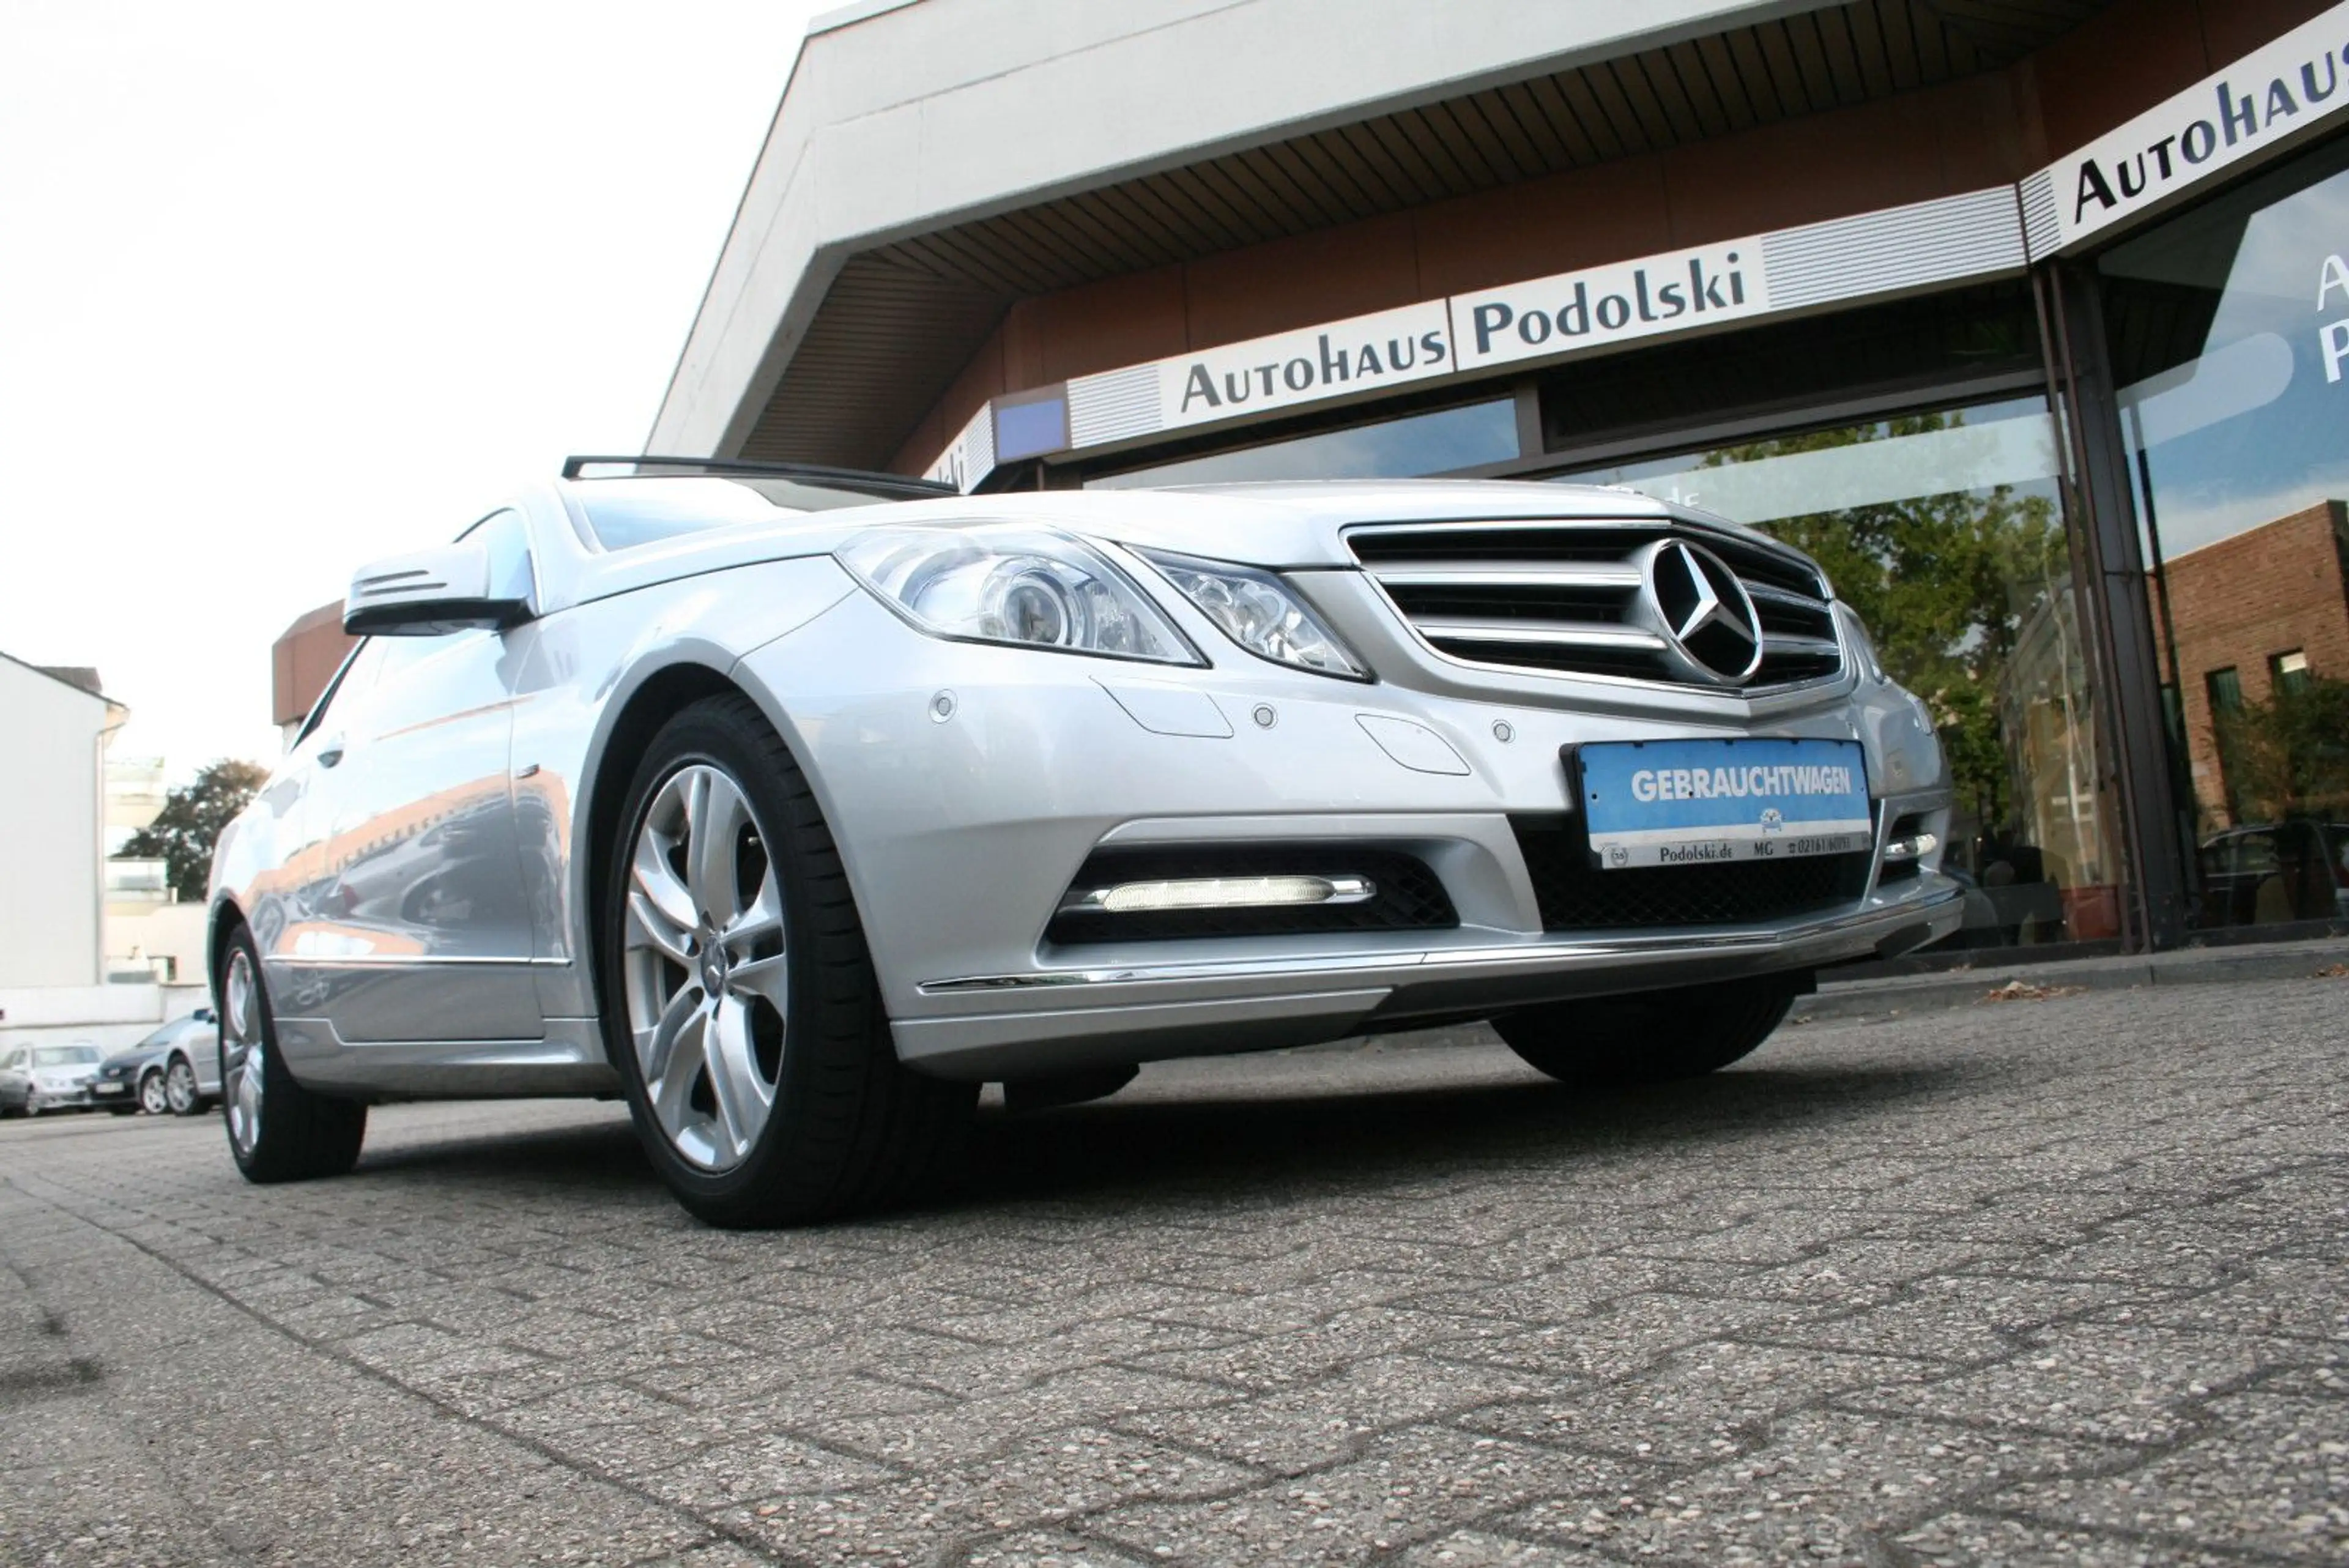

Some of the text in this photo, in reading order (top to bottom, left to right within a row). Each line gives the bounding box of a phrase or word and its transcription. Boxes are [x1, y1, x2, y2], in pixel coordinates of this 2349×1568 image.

[1473, 252, 1744, 354] Podolski
[1631, 765, 1850, 801] GEBRAUCHTWAGEN
[1660, 842, 1732, 862] Podolski.de
[1754, 841, 1773, 856] MG
